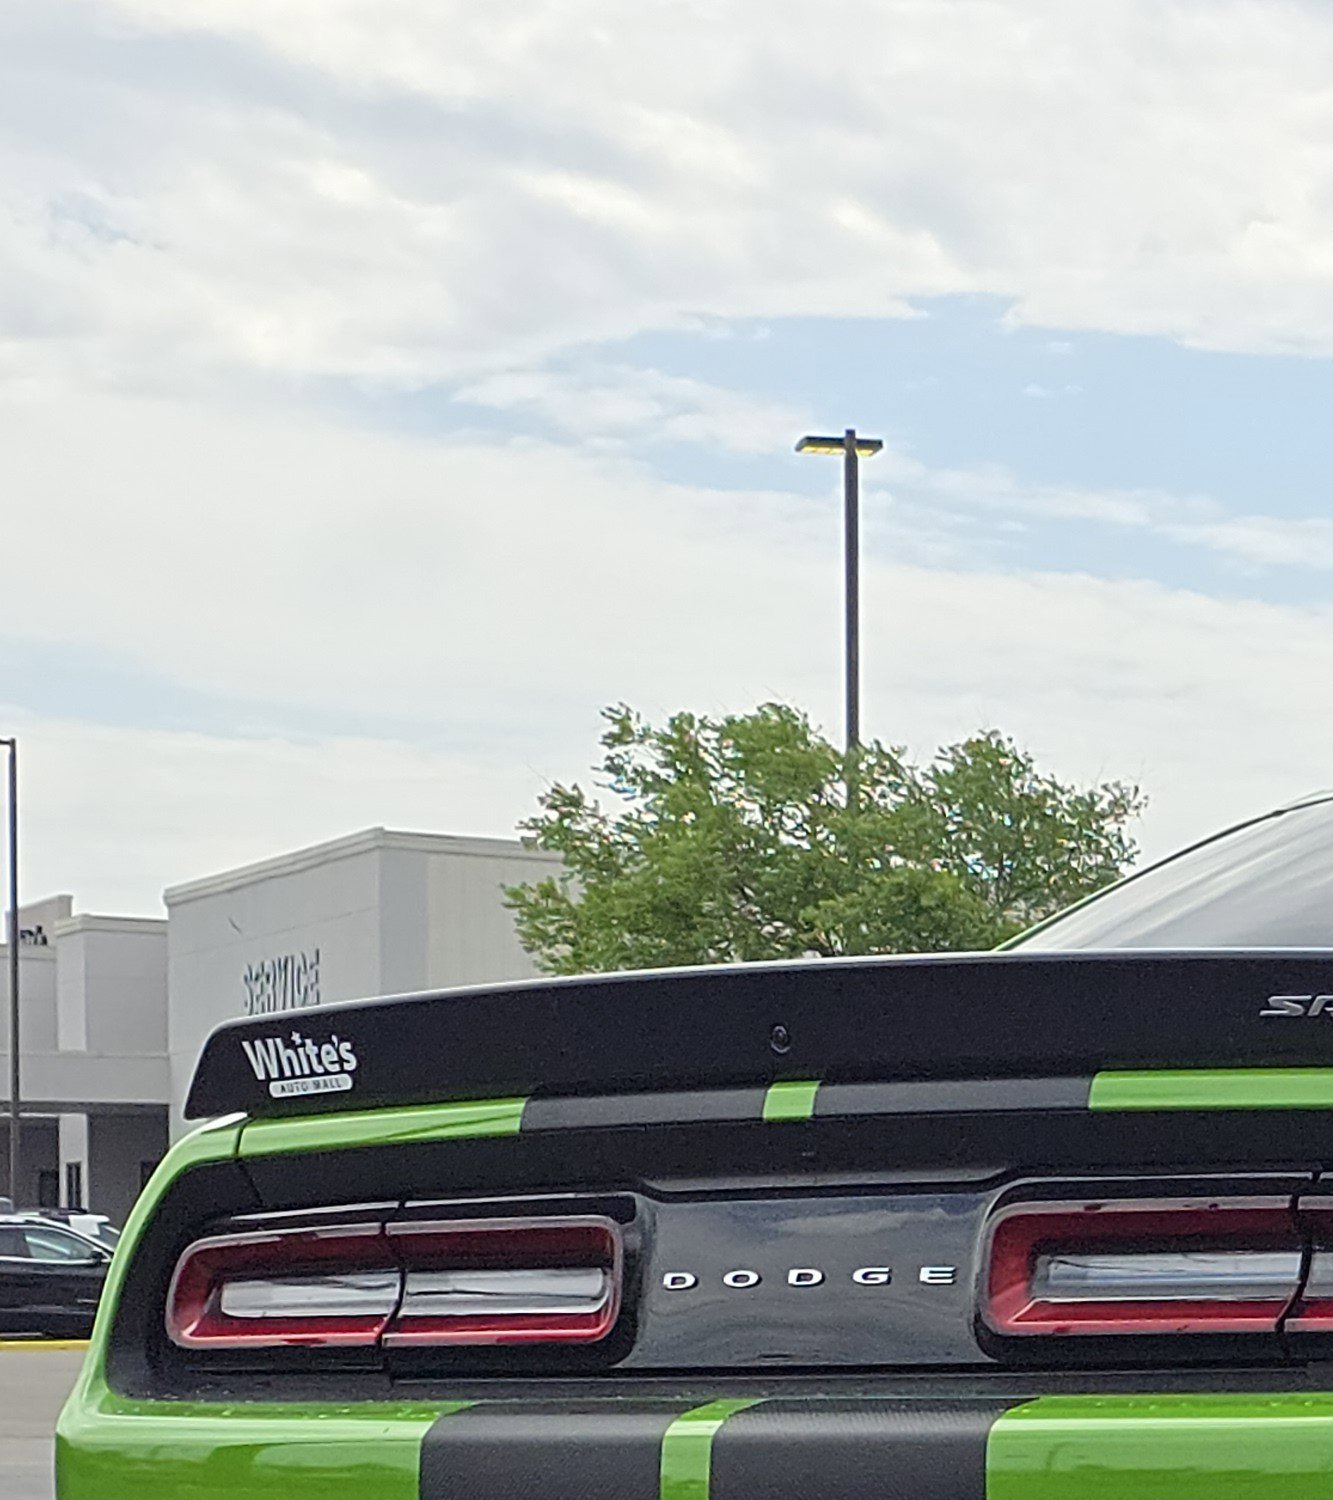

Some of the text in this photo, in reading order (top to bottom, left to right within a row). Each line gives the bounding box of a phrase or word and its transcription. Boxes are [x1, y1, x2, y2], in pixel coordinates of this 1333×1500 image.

[243, 948, 320, 1016] SERVICE
[242, 1031, 358, 1080] White's
[280, 1078, 342, 1094] AUTO MALL
[662, 1266, 957, 1290] DODGE
